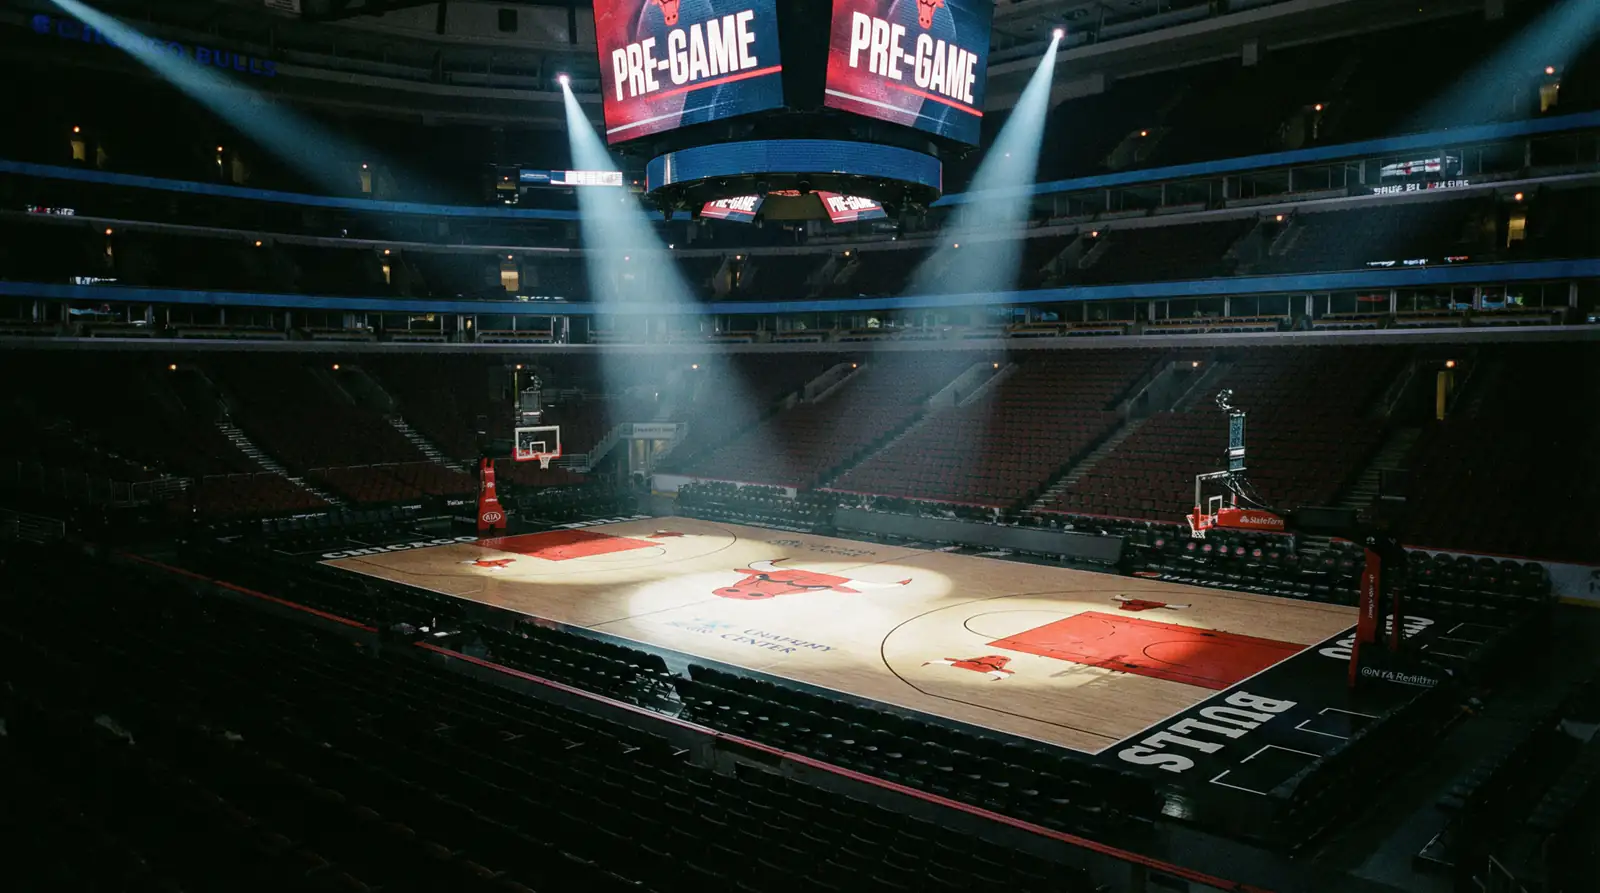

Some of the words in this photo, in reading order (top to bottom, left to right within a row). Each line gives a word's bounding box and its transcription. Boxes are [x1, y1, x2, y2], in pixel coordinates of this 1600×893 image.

[196, 45, 278, 77] BULLS
[612, 9, 758, 101] PRE-GAME
[849, 11, 978, 103] PRE-GAME
[1117, 690, 1298, 773] BULLS
